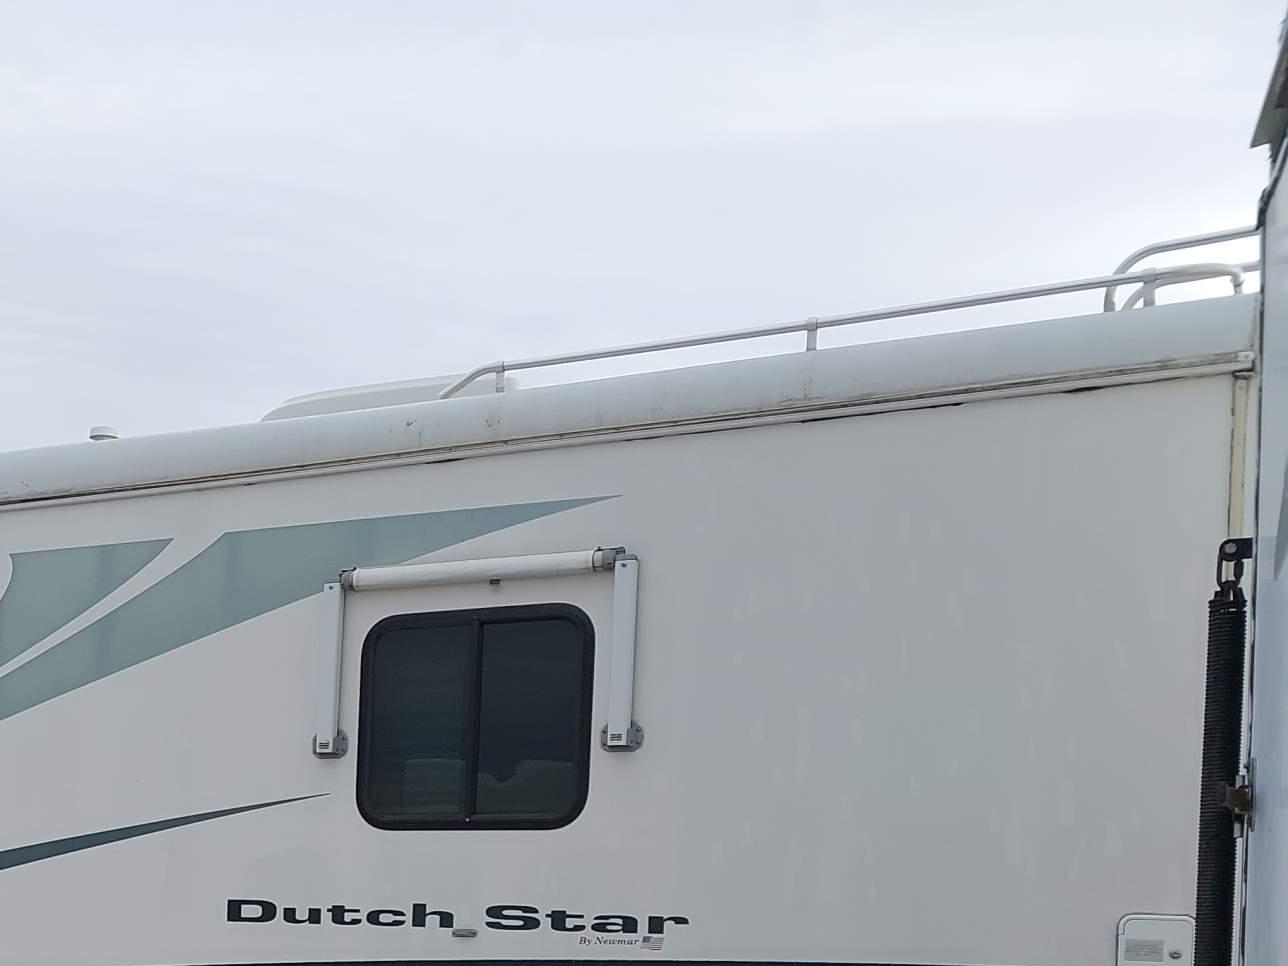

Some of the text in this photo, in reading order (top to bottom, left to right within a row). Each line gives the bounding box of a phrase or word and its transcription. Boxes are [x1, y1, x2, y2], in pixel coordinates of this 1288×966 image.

[226, 898, 690, 935] Dutch Star
[578, 936, 640, 947] By Newmar
